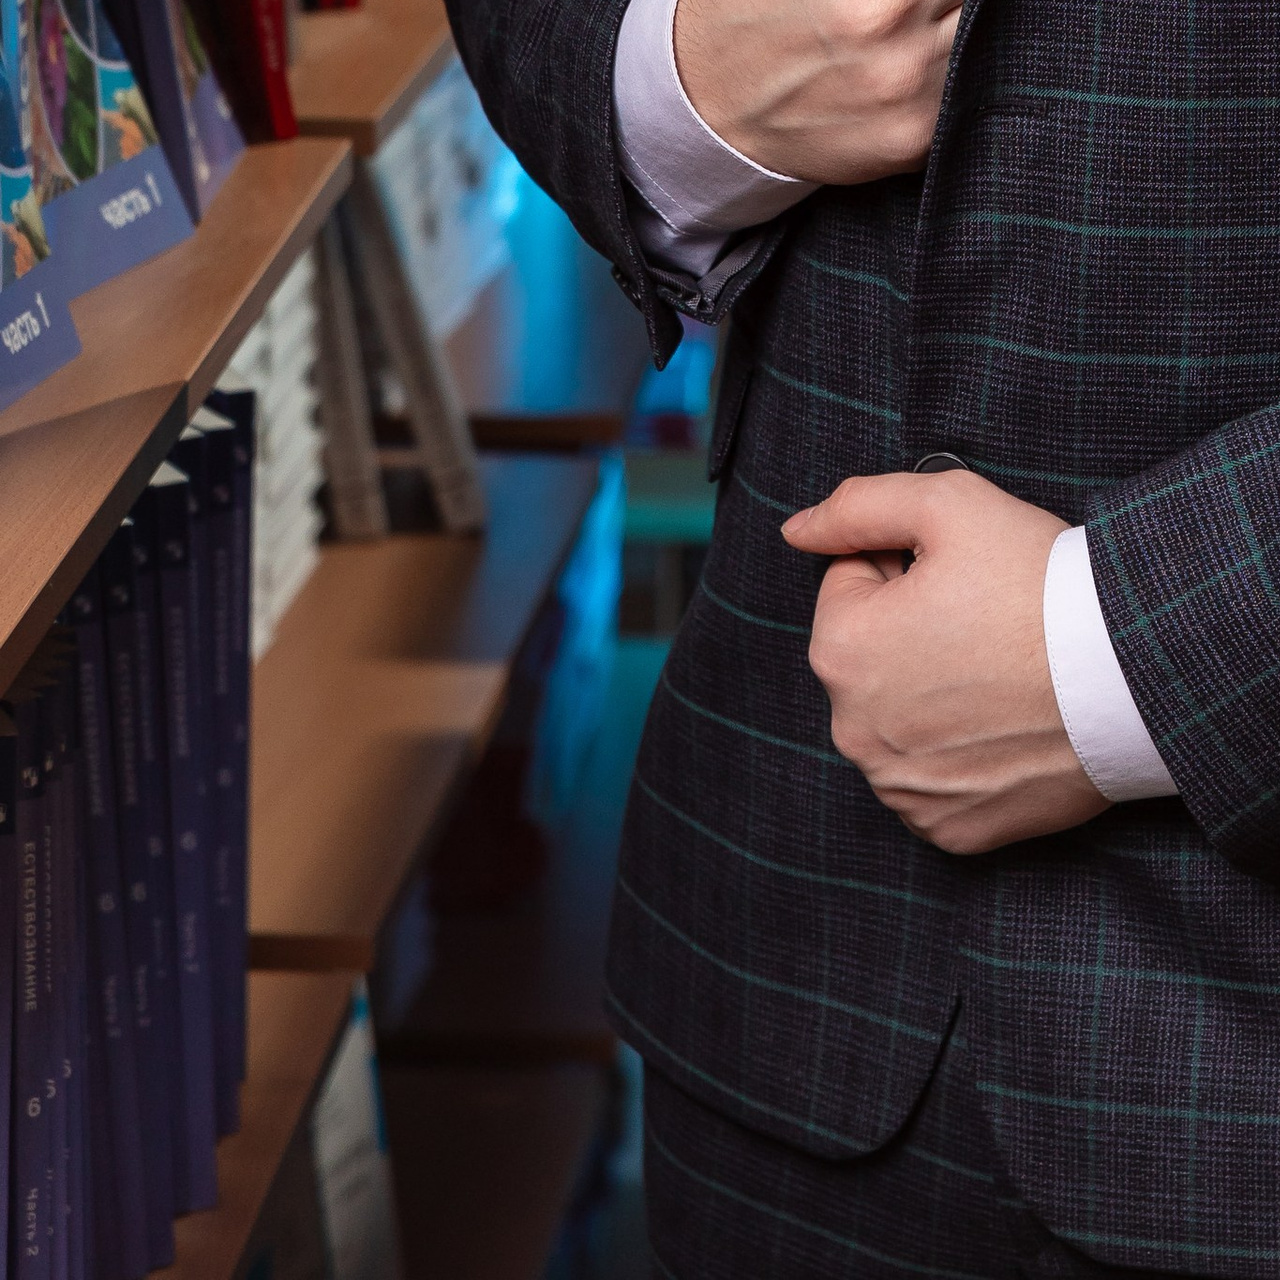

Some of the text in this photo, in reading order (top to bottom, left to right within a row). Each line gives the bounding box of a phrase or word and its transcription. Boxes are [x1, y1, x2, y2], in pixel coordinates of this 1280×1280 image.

[36, 292, 50, 328] 1
[24, 842, 37, 1013] ЕСТЕСТВОЗНАНИЕ
[28, 1097, 41, 1117] 6
[27, 1188, 39, 1256] Часть 2
